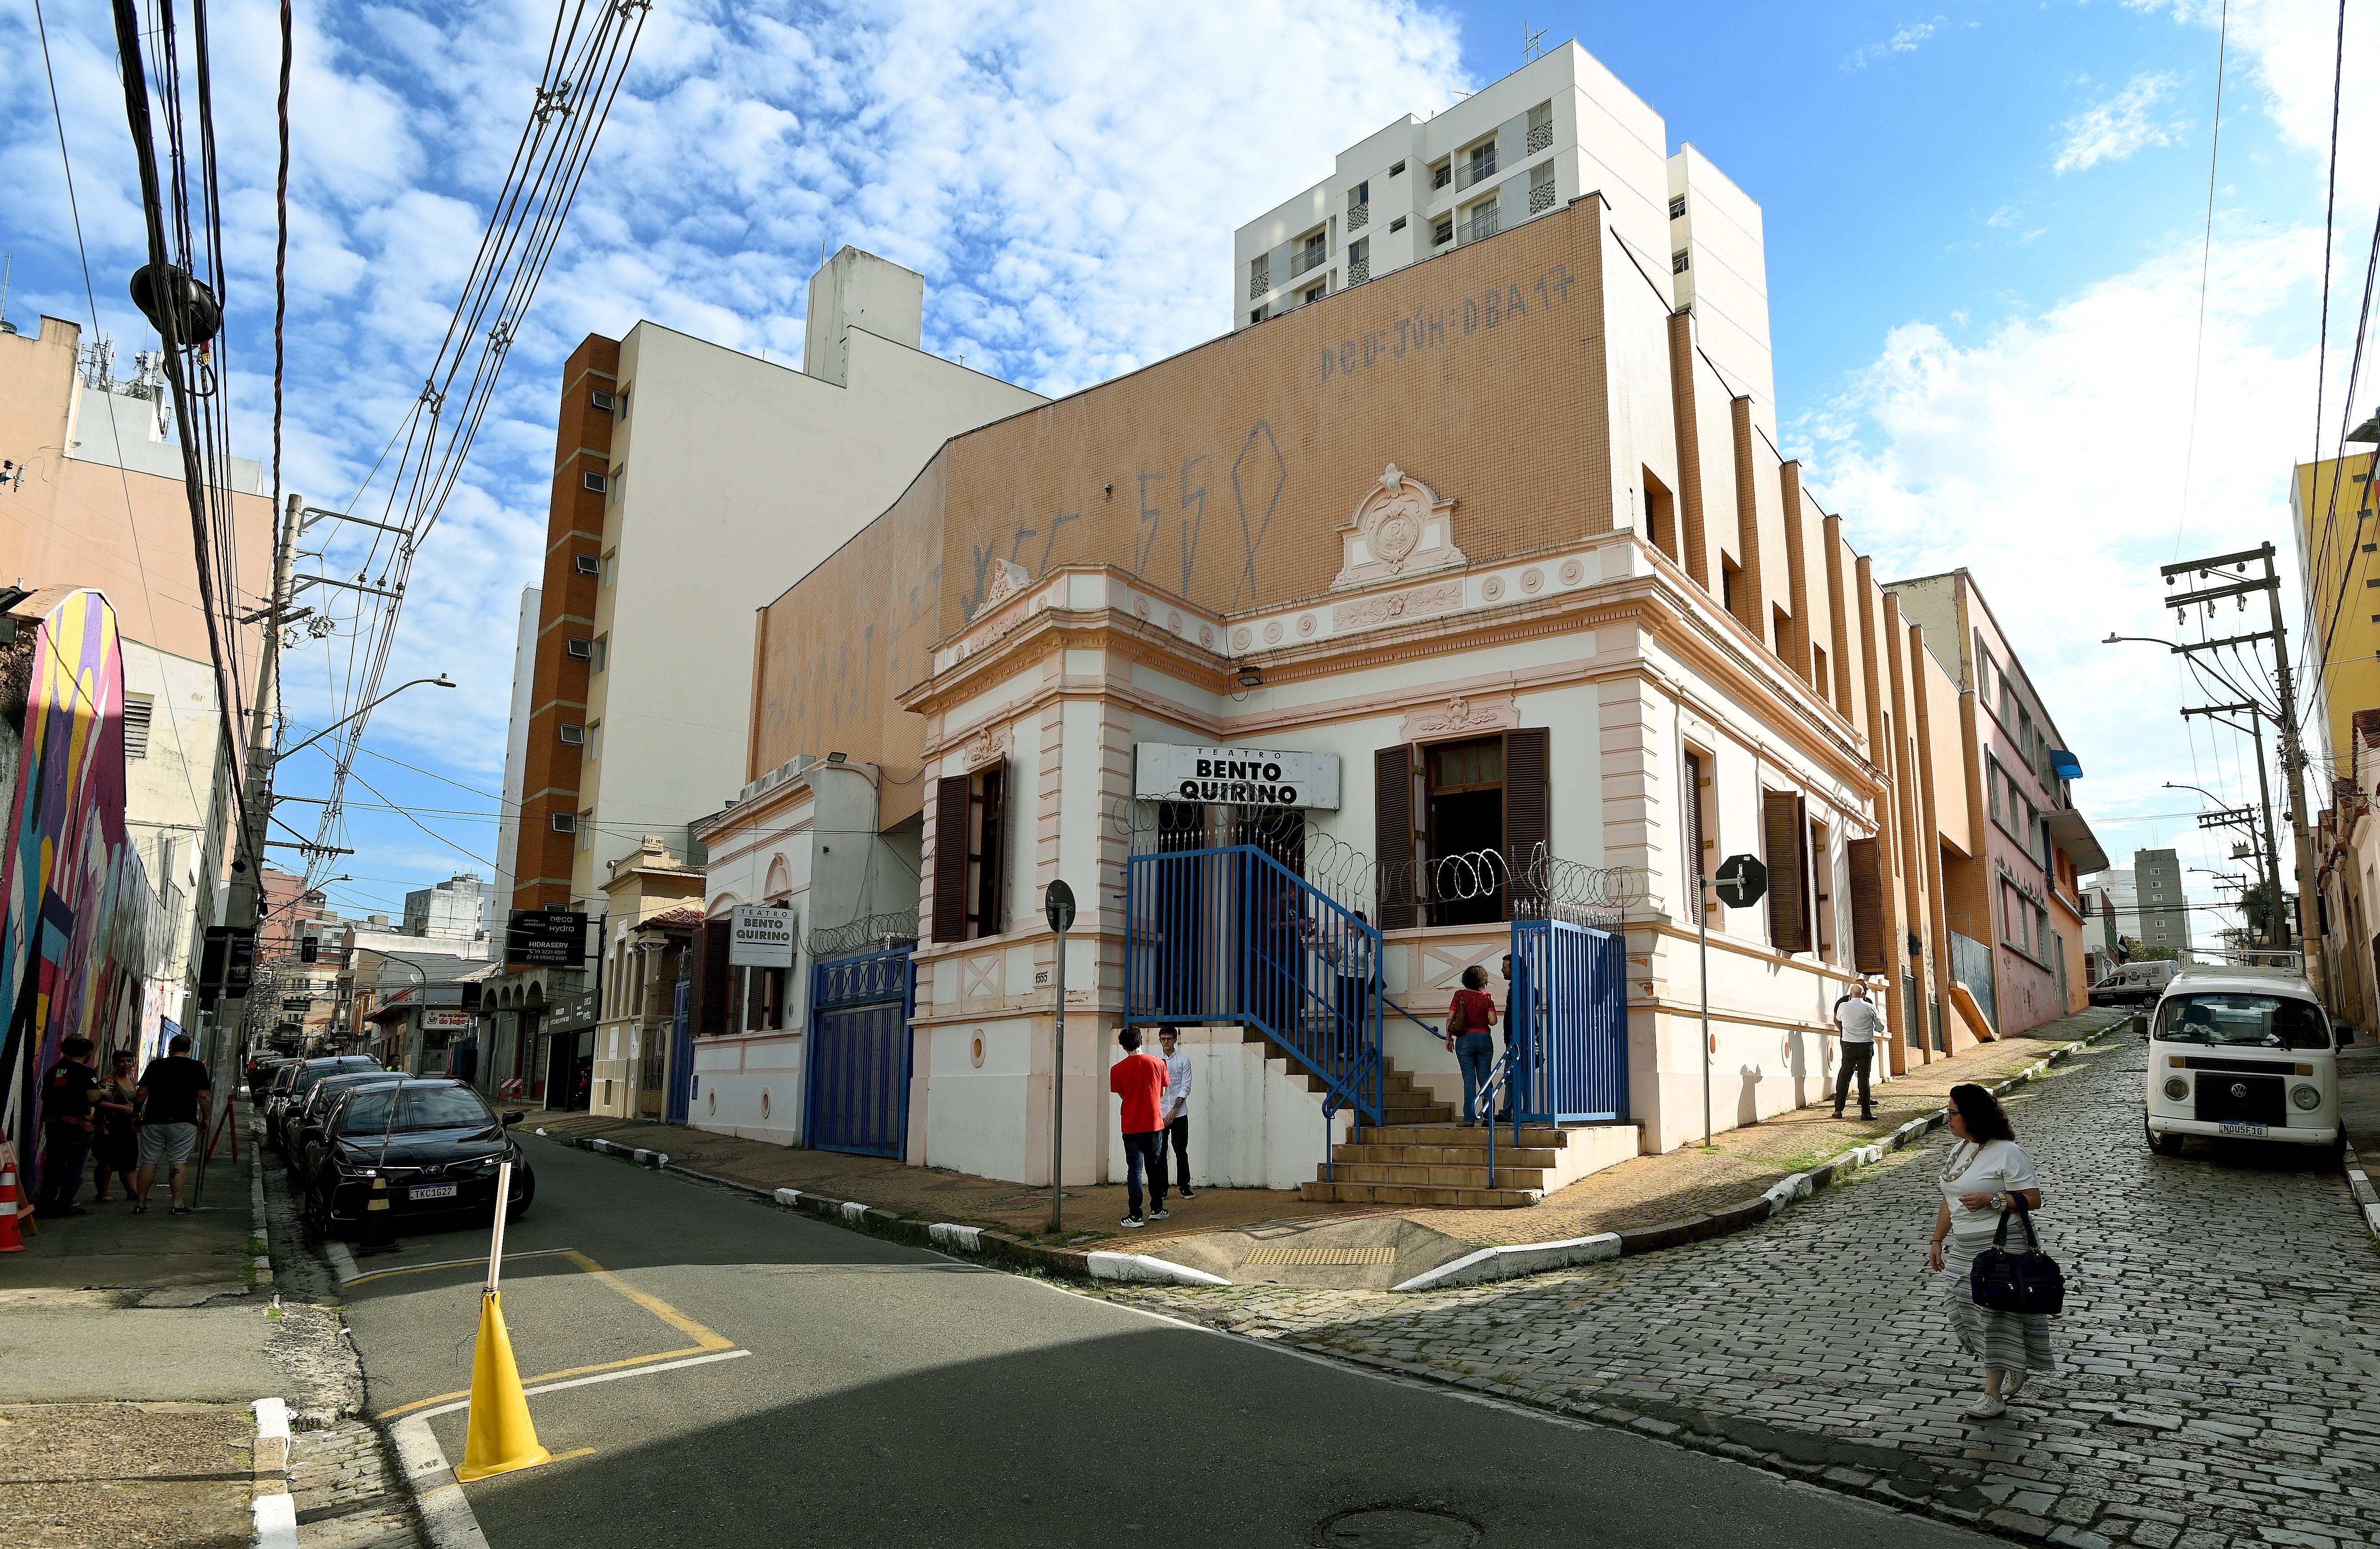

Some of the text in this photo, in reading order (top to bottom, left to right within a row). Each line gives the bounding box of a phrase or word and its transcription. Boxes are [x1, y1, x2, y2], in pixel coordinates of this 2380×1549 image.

[1198, 748, 1281, 759] TEATRO
[1196, 759, 1281, 782] BENTO
[1179, 780, 1297, 804] QUIRINO
[741, 909, 787, 917] TEATRO
[744, 918, 783, 929] BENTO
[736, 929, 790, 941] QUIRINO
[1035, 970, 1048, 983] 1555
[2223, 1124, 2262, 1135] NOU5F10
[415, 1187, 452, 1198] TKC1G27
